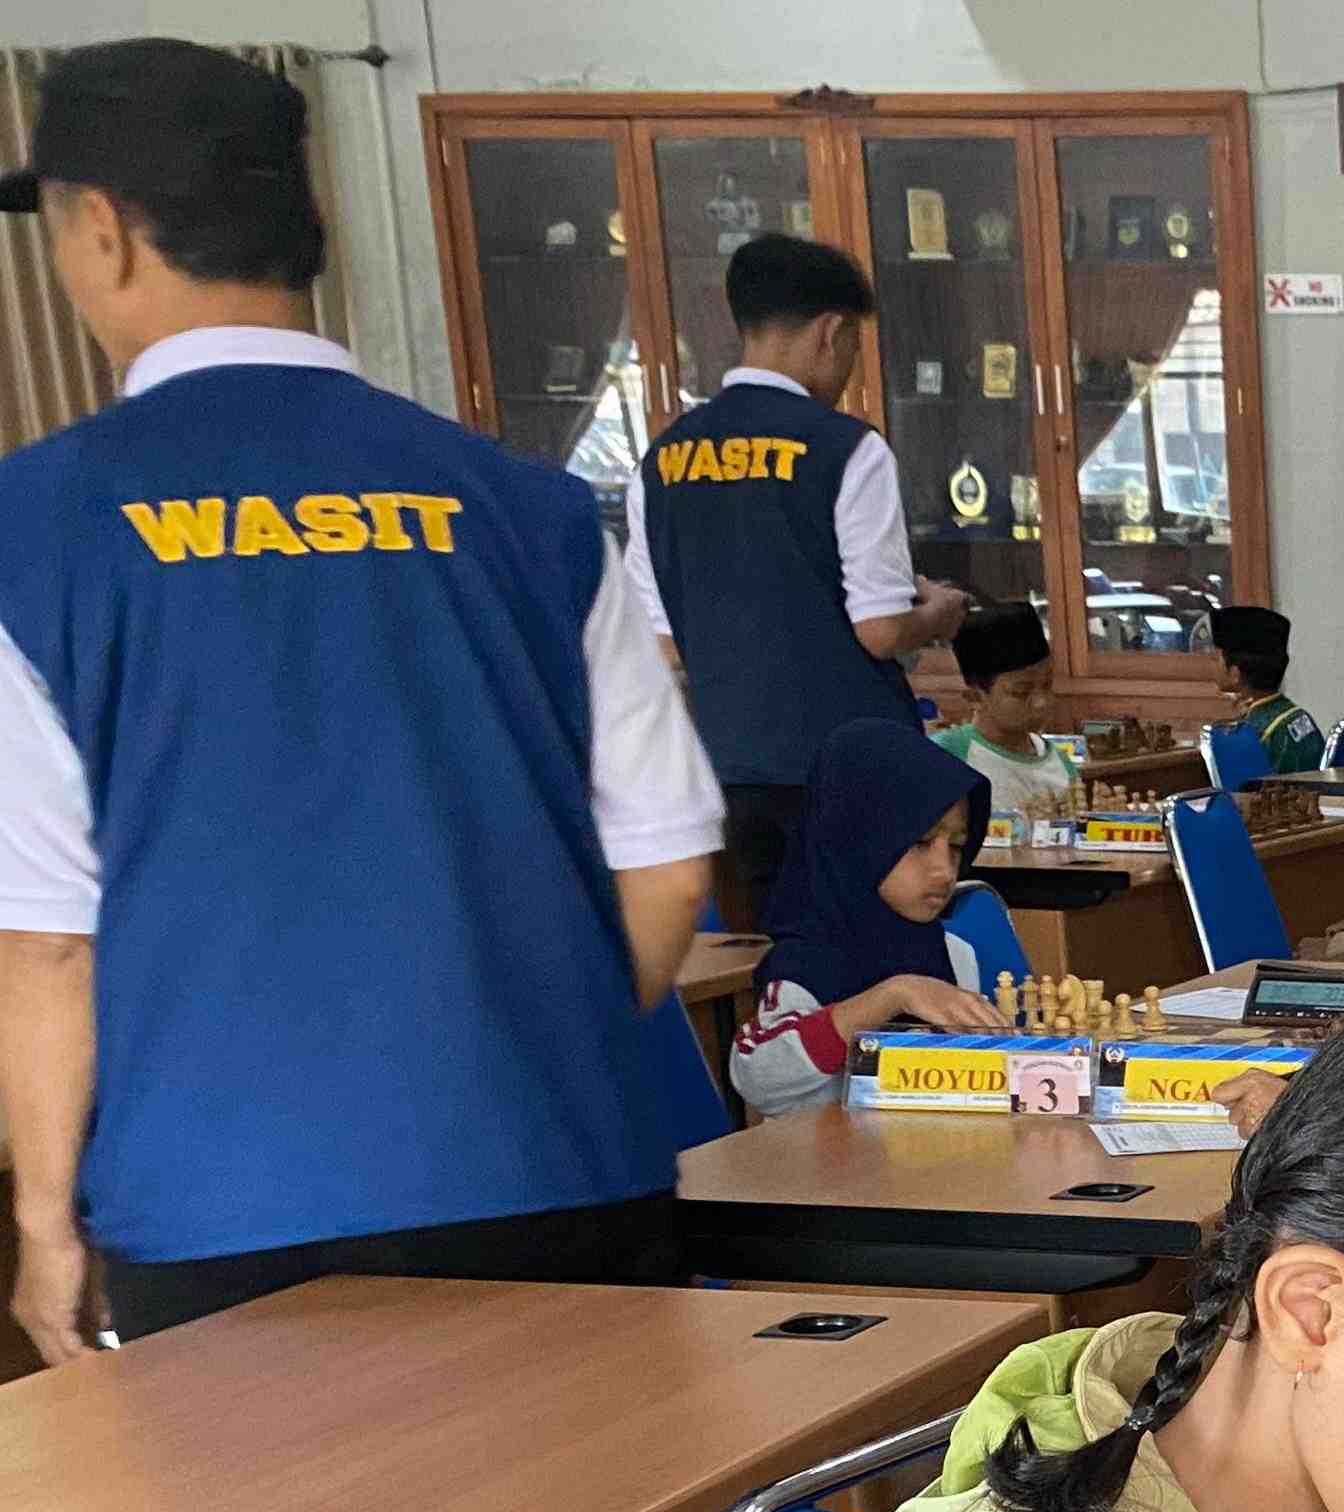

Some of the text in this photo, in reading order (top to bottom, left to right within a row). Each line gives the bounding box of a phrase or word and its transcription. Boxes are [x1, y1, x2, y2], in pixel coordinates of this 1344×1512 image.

[658, 437, 807, 486] WASIT
[121, 491, 463, 563] WASIT
[898, 1067, 1007, 1091] MOYUD
[1037, 1078, 1058, 1113] 3
[1149, 1078, 1212, 1101] NGA
